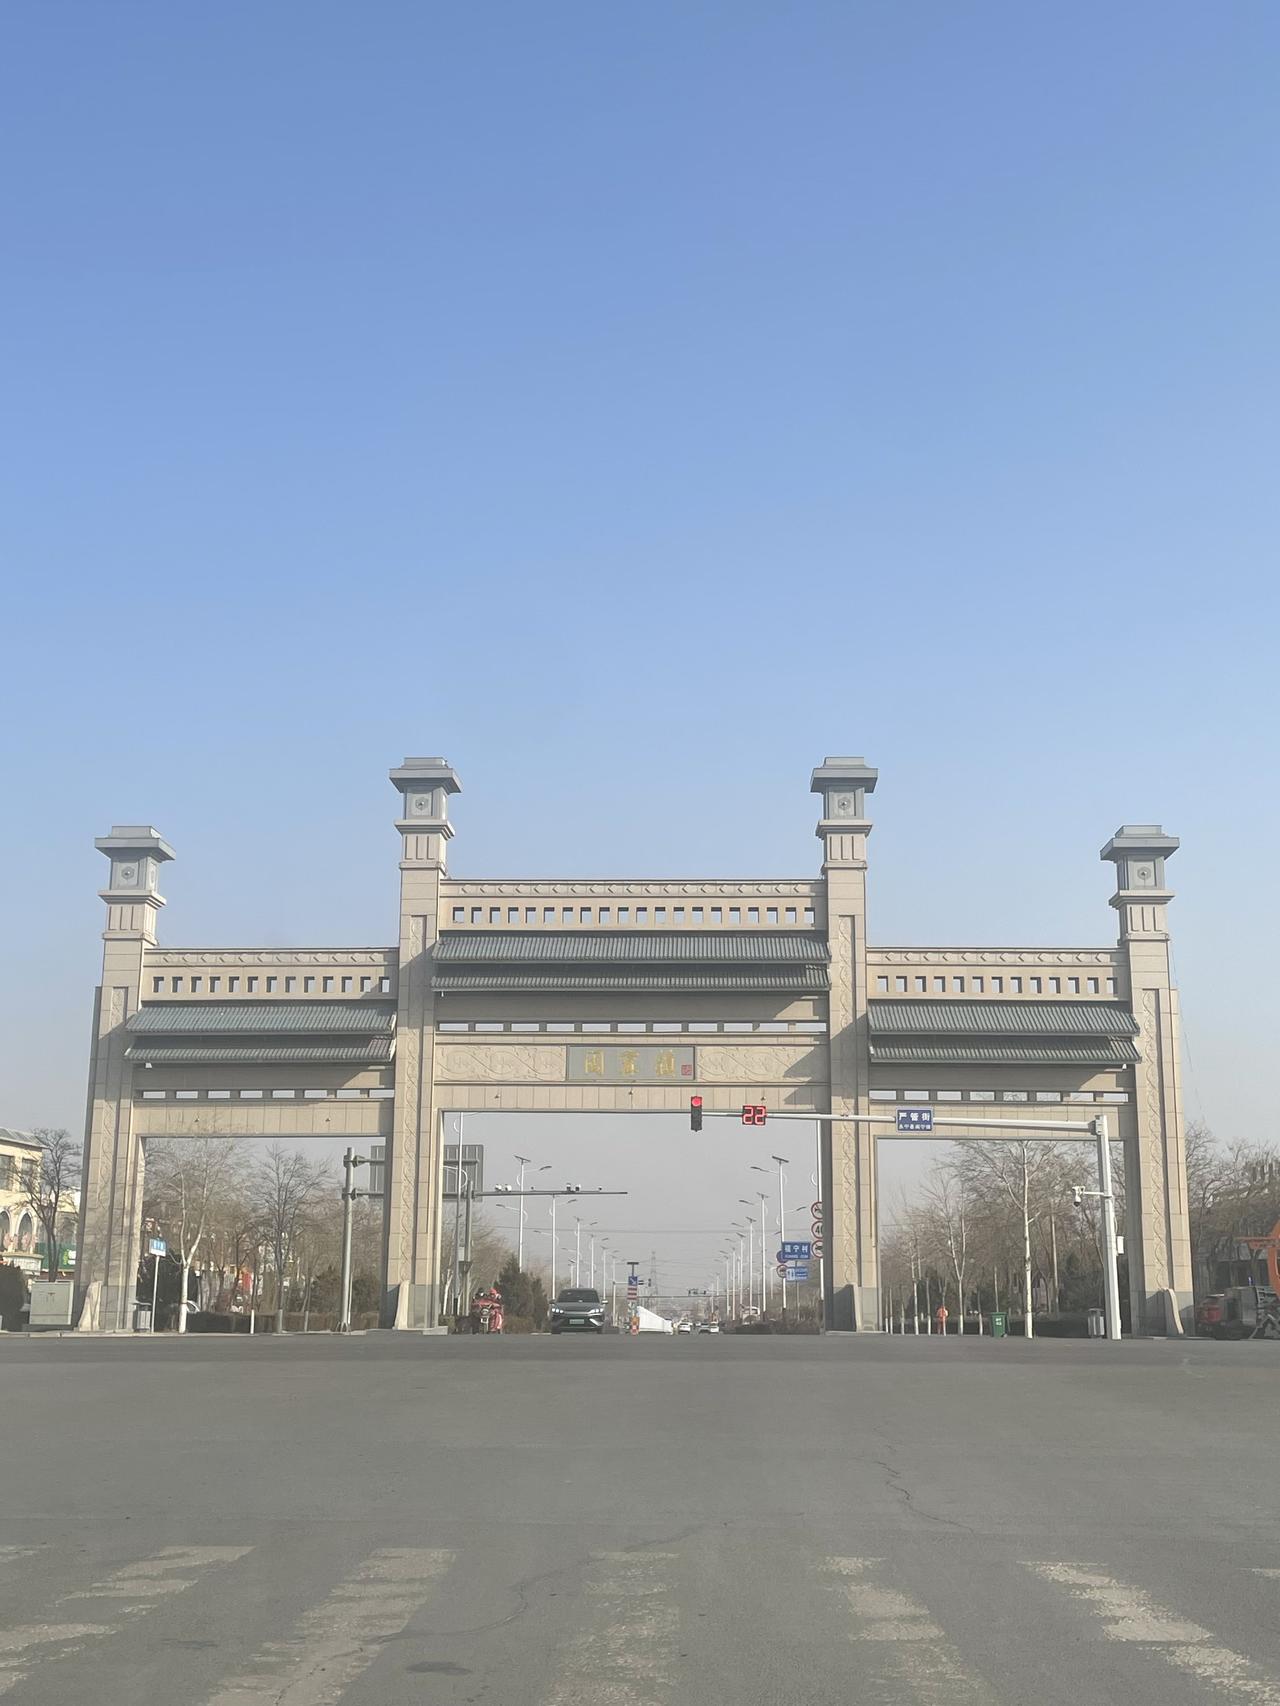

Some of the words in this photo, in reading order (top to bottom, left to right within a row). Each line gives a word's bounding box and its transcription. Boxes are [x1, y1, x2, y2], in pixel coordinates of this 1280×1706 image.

[743, 1106, 765, 1125] 22
[898, 1112, 930, 1121] 严管街
